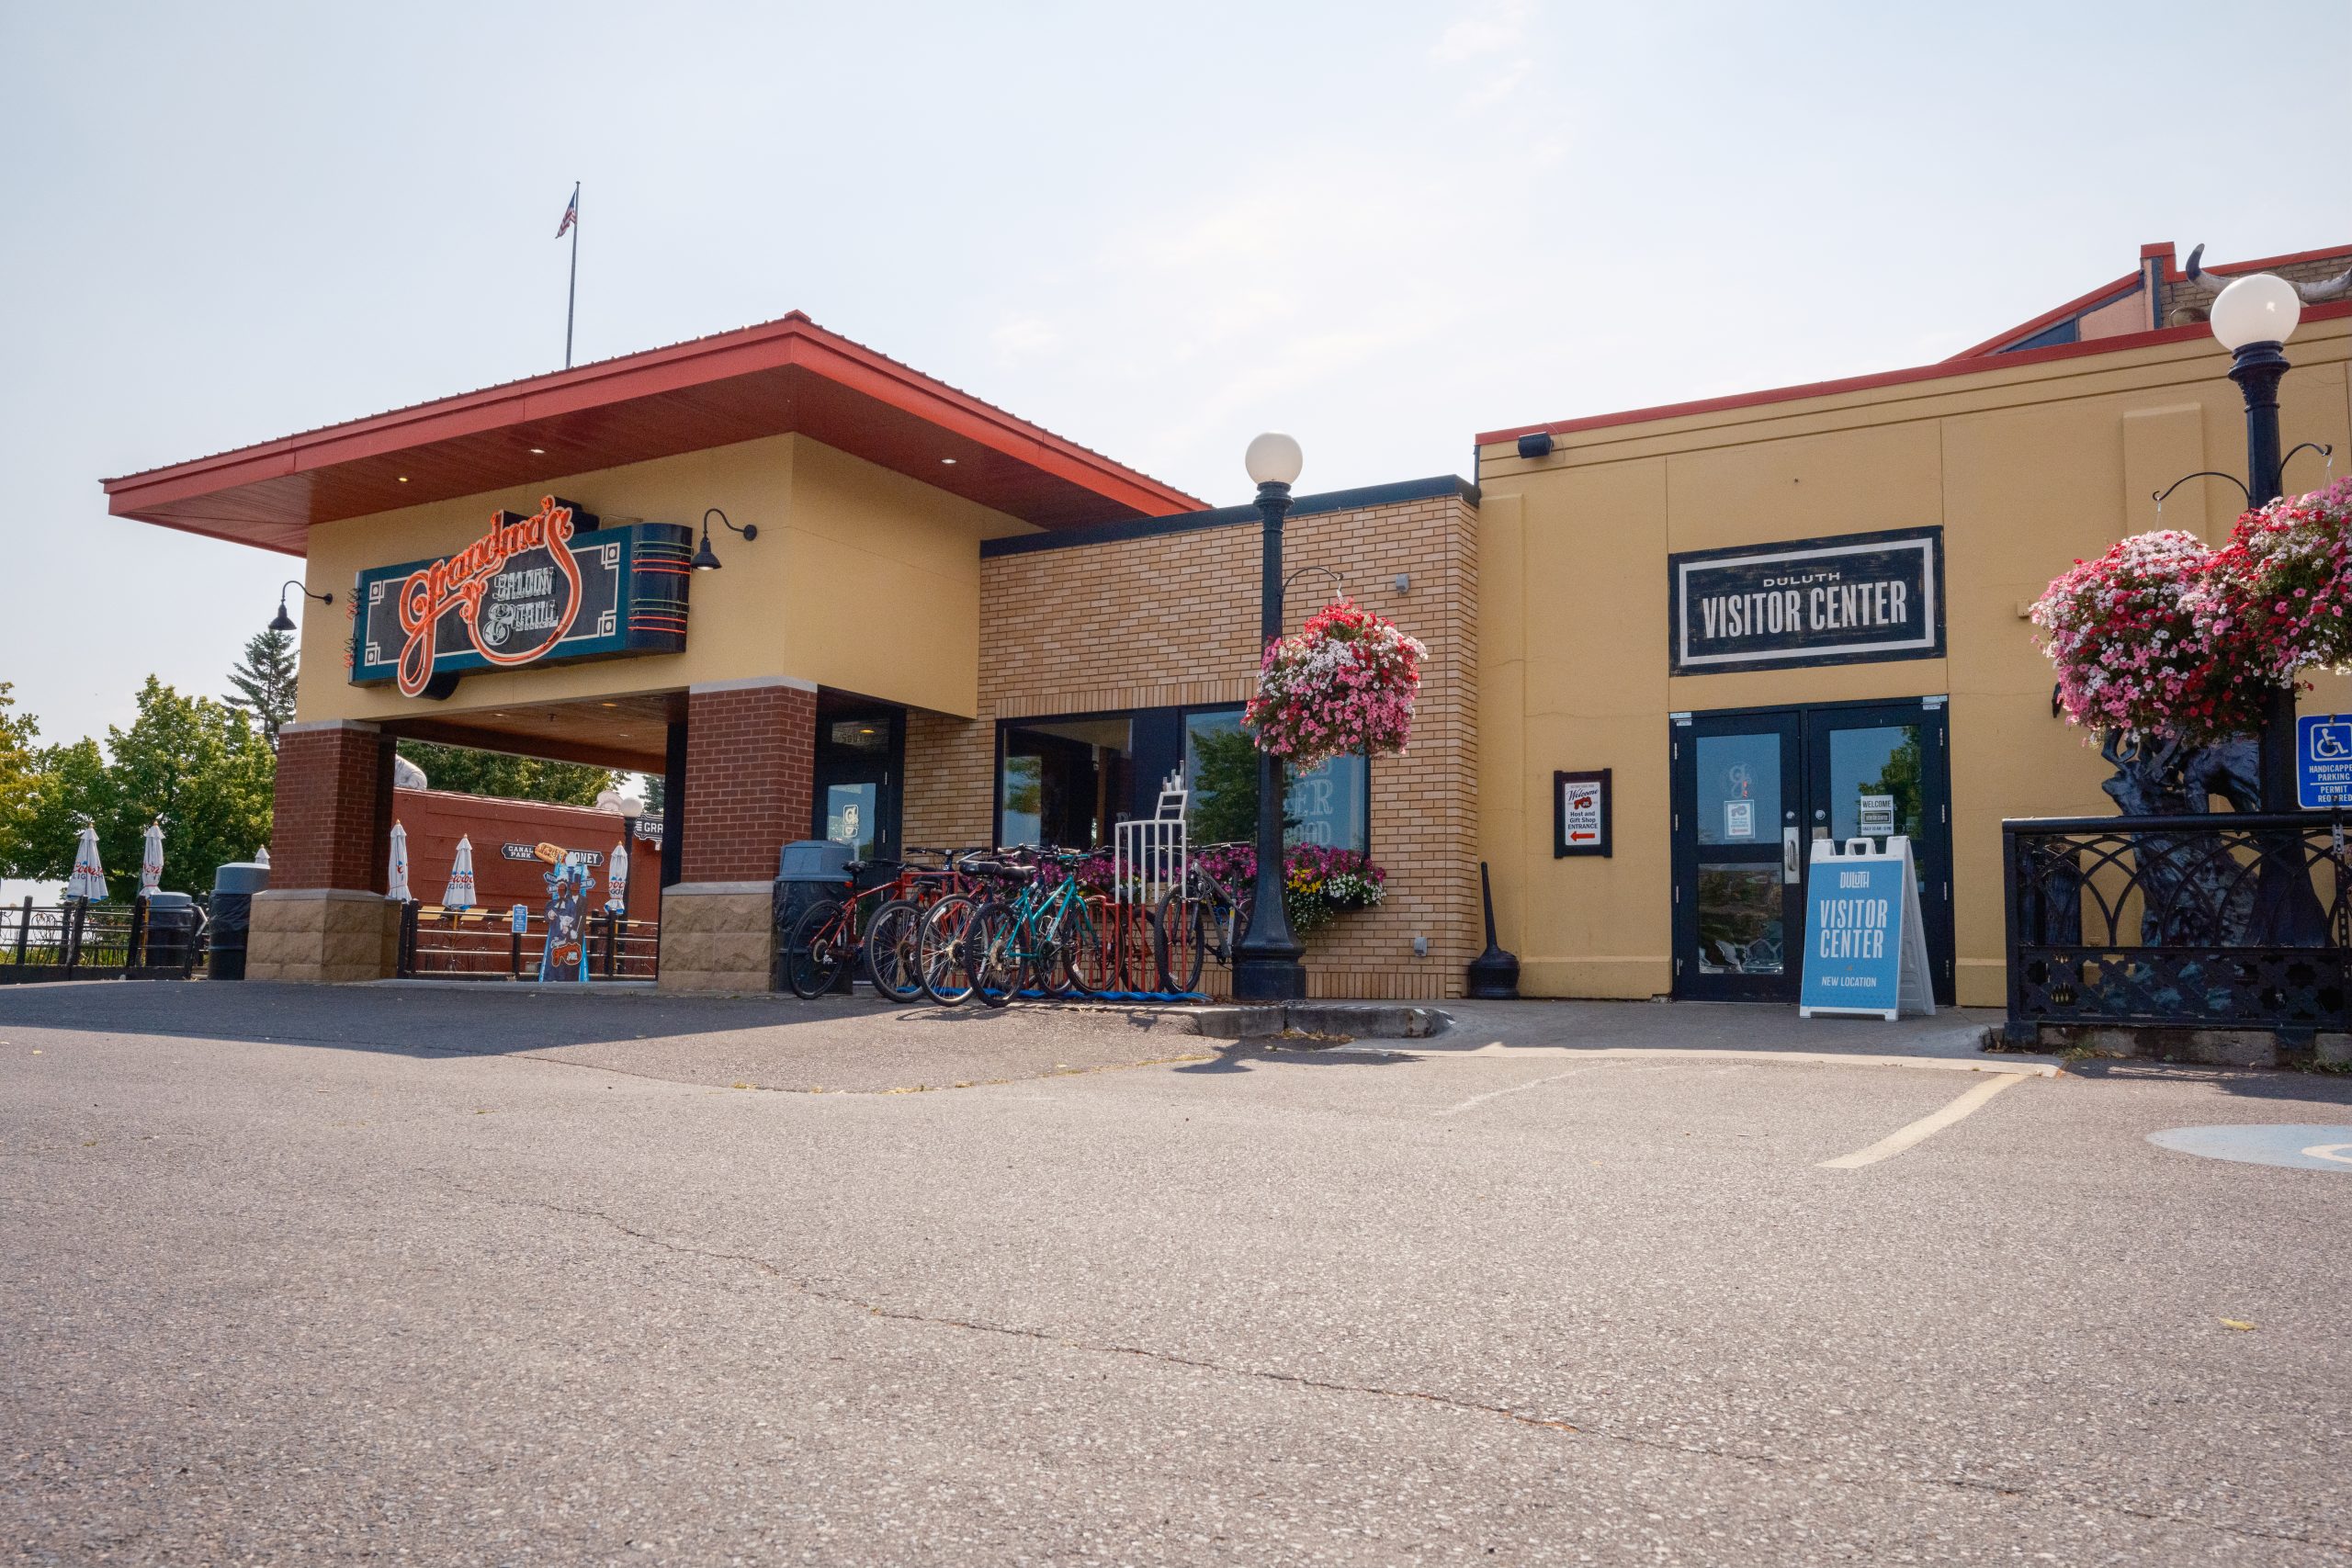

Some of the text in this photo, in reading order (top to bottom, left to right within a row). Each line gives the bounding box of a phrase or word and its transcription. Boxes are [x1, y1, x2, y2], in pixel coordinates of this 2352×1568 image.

[492, 567, 557, 602] SALOON
[1763, 572, 1840, 588] DULUTH
[511, 599, 560, 632] GRILL
[1702, 581, 1907, 638] VISITOR CENTER
[2309, 764, 2352, 773] HANDICAPPE
[2317, 773, 2350, 782] PARKING
[1566, 788, 1599, 801] Welcome
[2320, 785, 2348, 794] PERMIT
[1862, 800, 1892, 808] WELCOME
[2317, 794, 2352, 803] REQRED
[575, 852, 598, 863] ONEY
[1840, 872, 1870, 888] DULUTH
[1820, 899, 1888, 929] VISITOR
[1820, 929, 1884, 959] CENTER
[1822, 976, 1877, 987] NEW LOCATION
